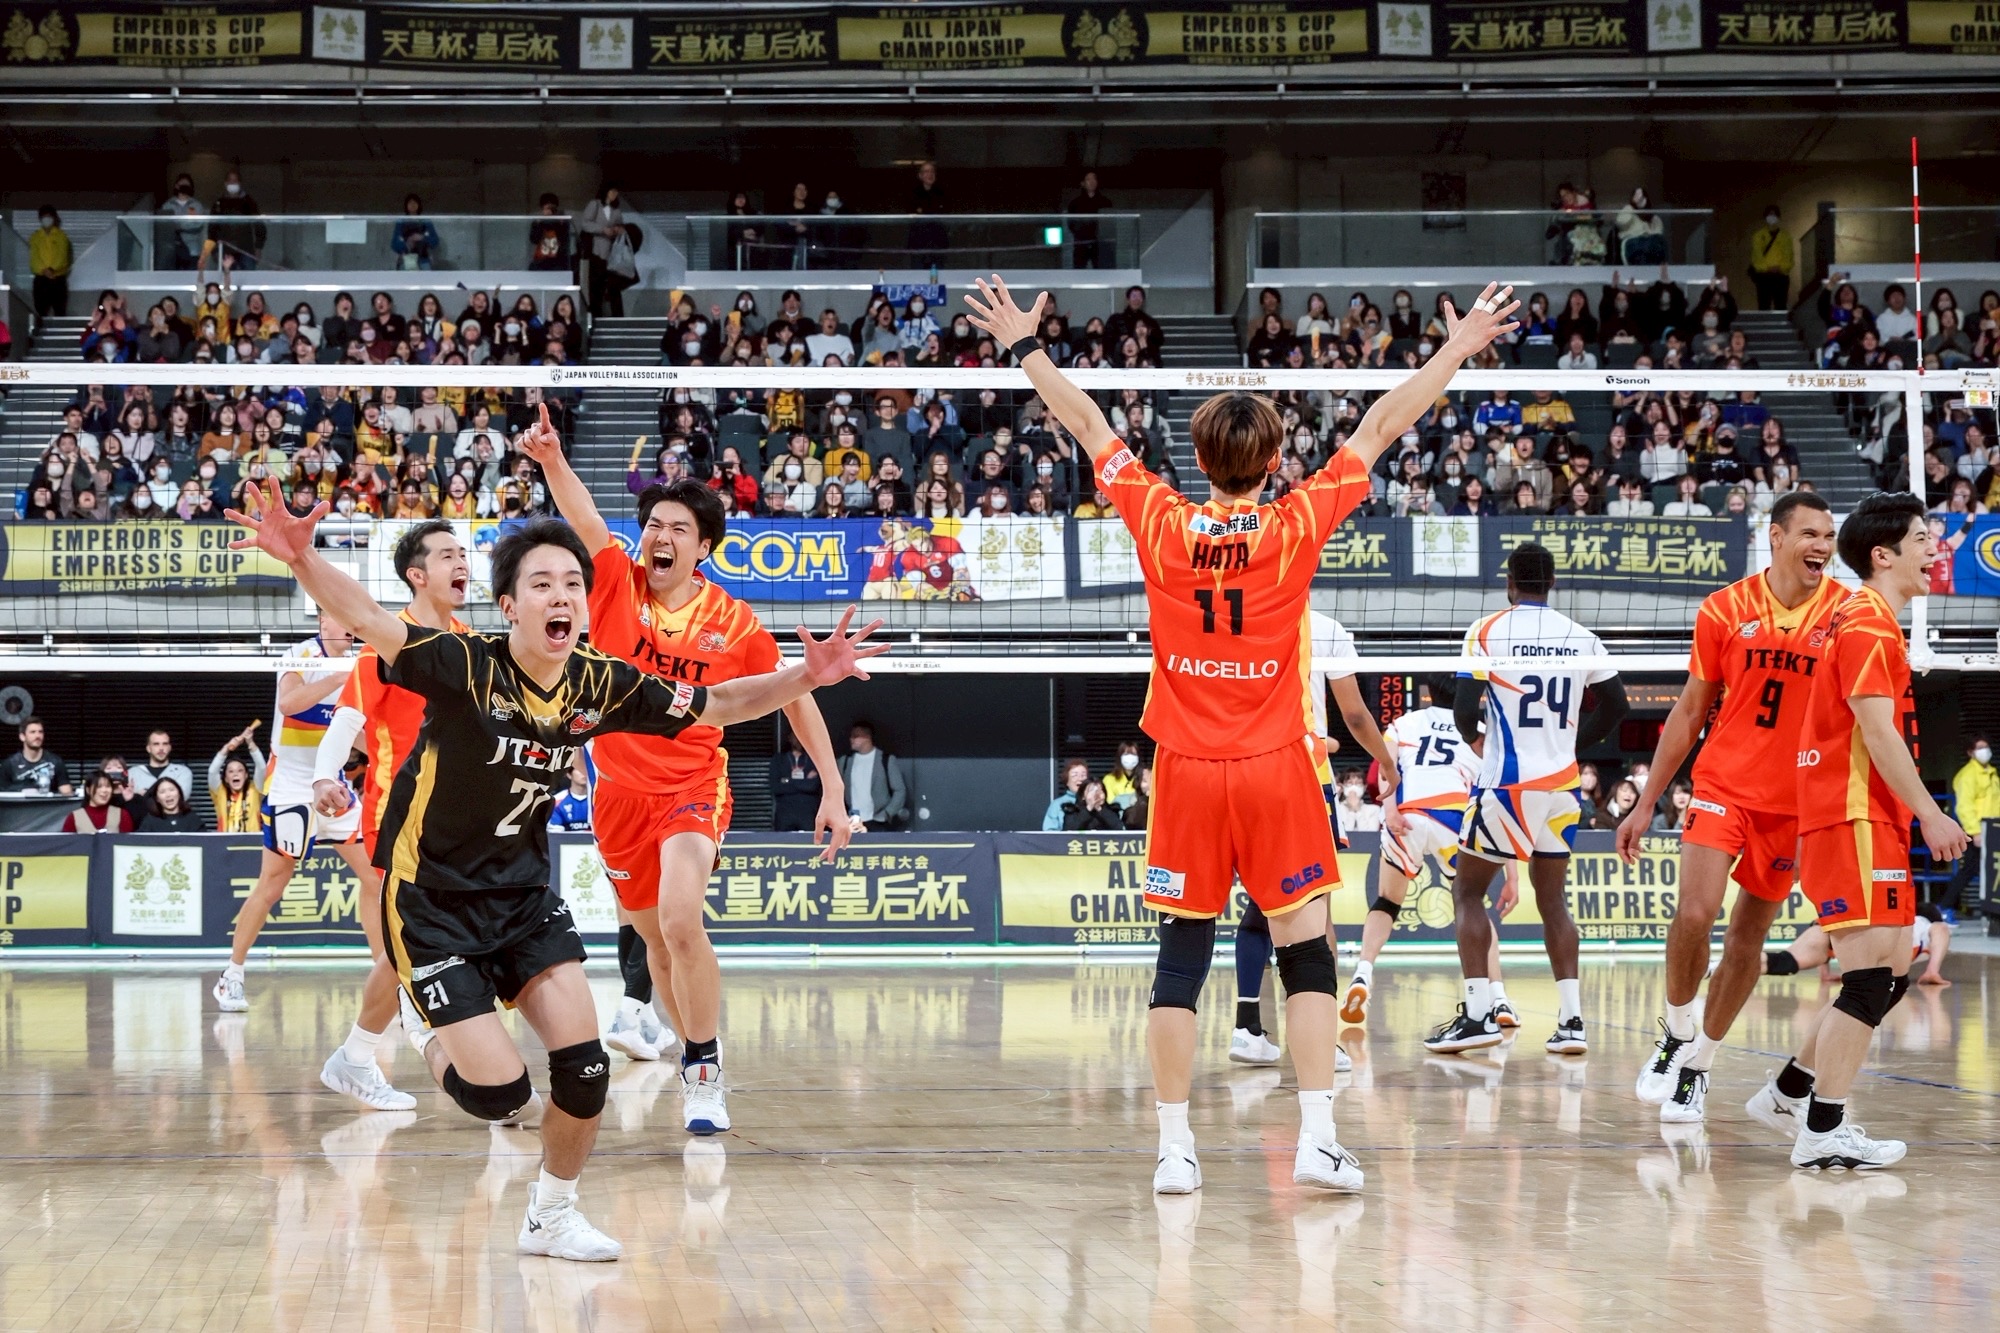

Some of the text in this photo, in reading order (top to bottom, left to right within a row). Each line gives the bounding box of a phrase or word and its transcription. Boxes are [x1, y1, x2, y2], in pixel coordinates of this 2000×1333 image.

[113, 17, 266, 36] EMPEROR'S CUP
[903, 19, 1002, 38] ALL JAPAN
[1182, 15, 1335, 34] EMPEROR'S CUP
[113, 37, 265, 55] EMPRESS'S CUP
[880, 39, 1025, 59] CHAMPIONSHIP
[1182, 34, 1335, 53] EMPRESS'S CUP
[564, 371, 678, 380] JAPAN VOLLEYBALL ASSOCIATION
[1616, 377, 1650, 385] Senoh
[1208, 514, 1259, 536] 奥村組
[53, 529, 184, 551] EMPEROR'S
[52, 553, 245, 577] EMPRESS'S CUP
[1190, 541, 1250, 570] HATA
[1194, 588, 1244, 636] 11
[629, 634, 710, 683] JTEKT
[1743, 648, 1818, 677] JTEKT
[1381, 676, 1402, 691] 25
[1381, 693, 1402, 708] 20
[1518, 674, 1571, 730] 24
[1755, 678, 1784, 730] 9
[1431, 720, 1457, 732] LEE
[1414, 736, 1459, 767] 15
[283, 839, 295, 854] 11
[1887, 888, 1898, 910] 6
[422, 979, 451, 1011] 21
